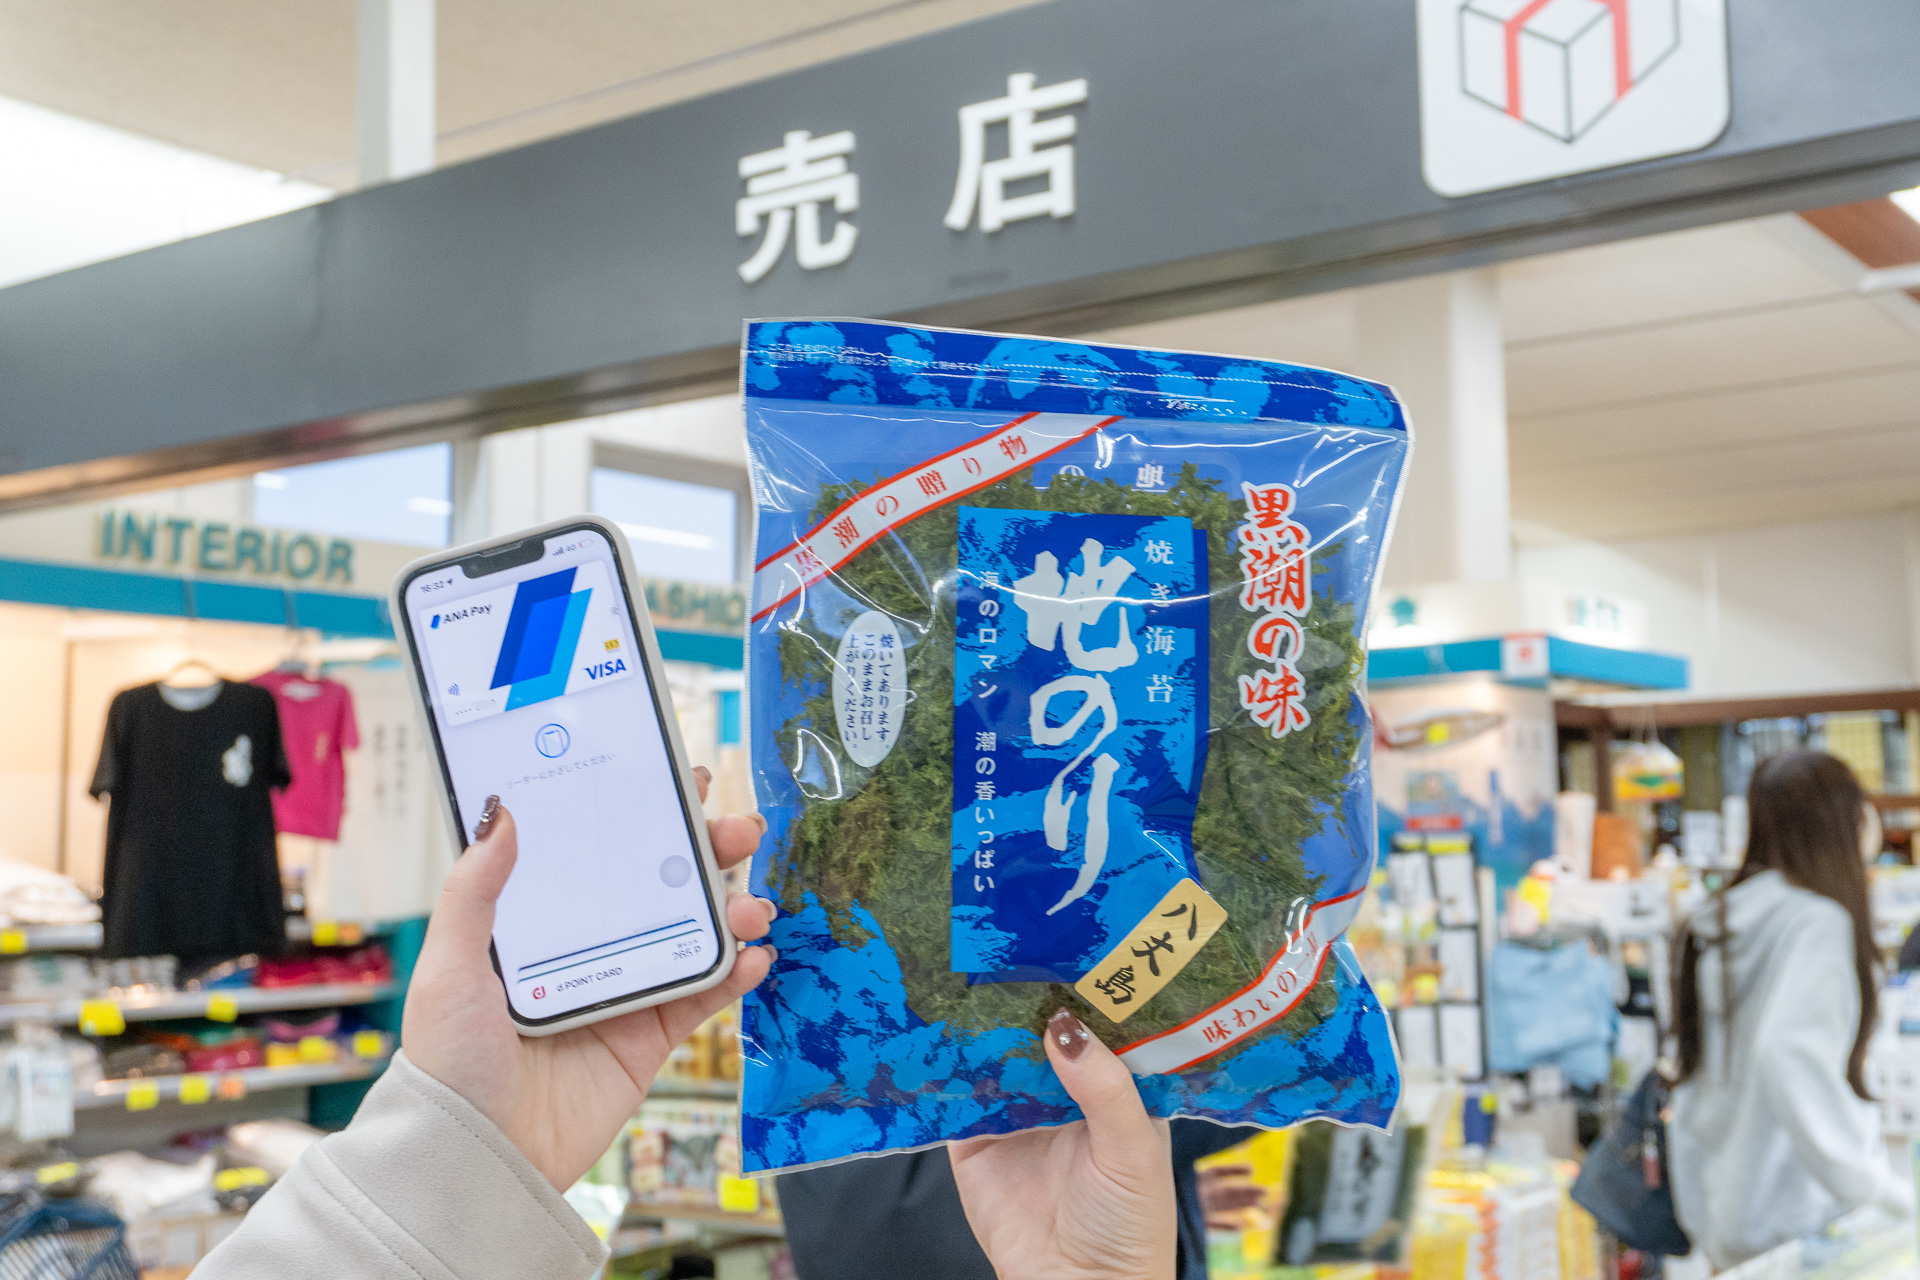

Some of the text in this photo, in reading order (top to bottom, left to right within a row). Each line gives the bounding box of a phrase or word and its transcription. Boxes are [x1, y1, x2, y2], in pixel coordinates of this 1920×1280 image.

[736, 72, 1088, 283] 売店
[101, 511, 357, 584] INTERIOR
[794, 435, 1027, 577] 黒潮の贈り物
[442, 604, 493, 625] ANA Pay
[584, 658, 626, 680] VISA
[1144, 539, 1176, 704] 焼き海苔
[1240, 484, 1309, 736] 黒潮の味
[860, 634, 876, 741] このままお召し
[973, 570, 1000, 892] 海のロマン 潮の香いっぱい
[1013, 538, 1139, 916] 地のり
[564, 974, 594, 990] POINT
[595, 967, 624, 982] CARD
[1095, 903, 1197, 1005] 八丈島
